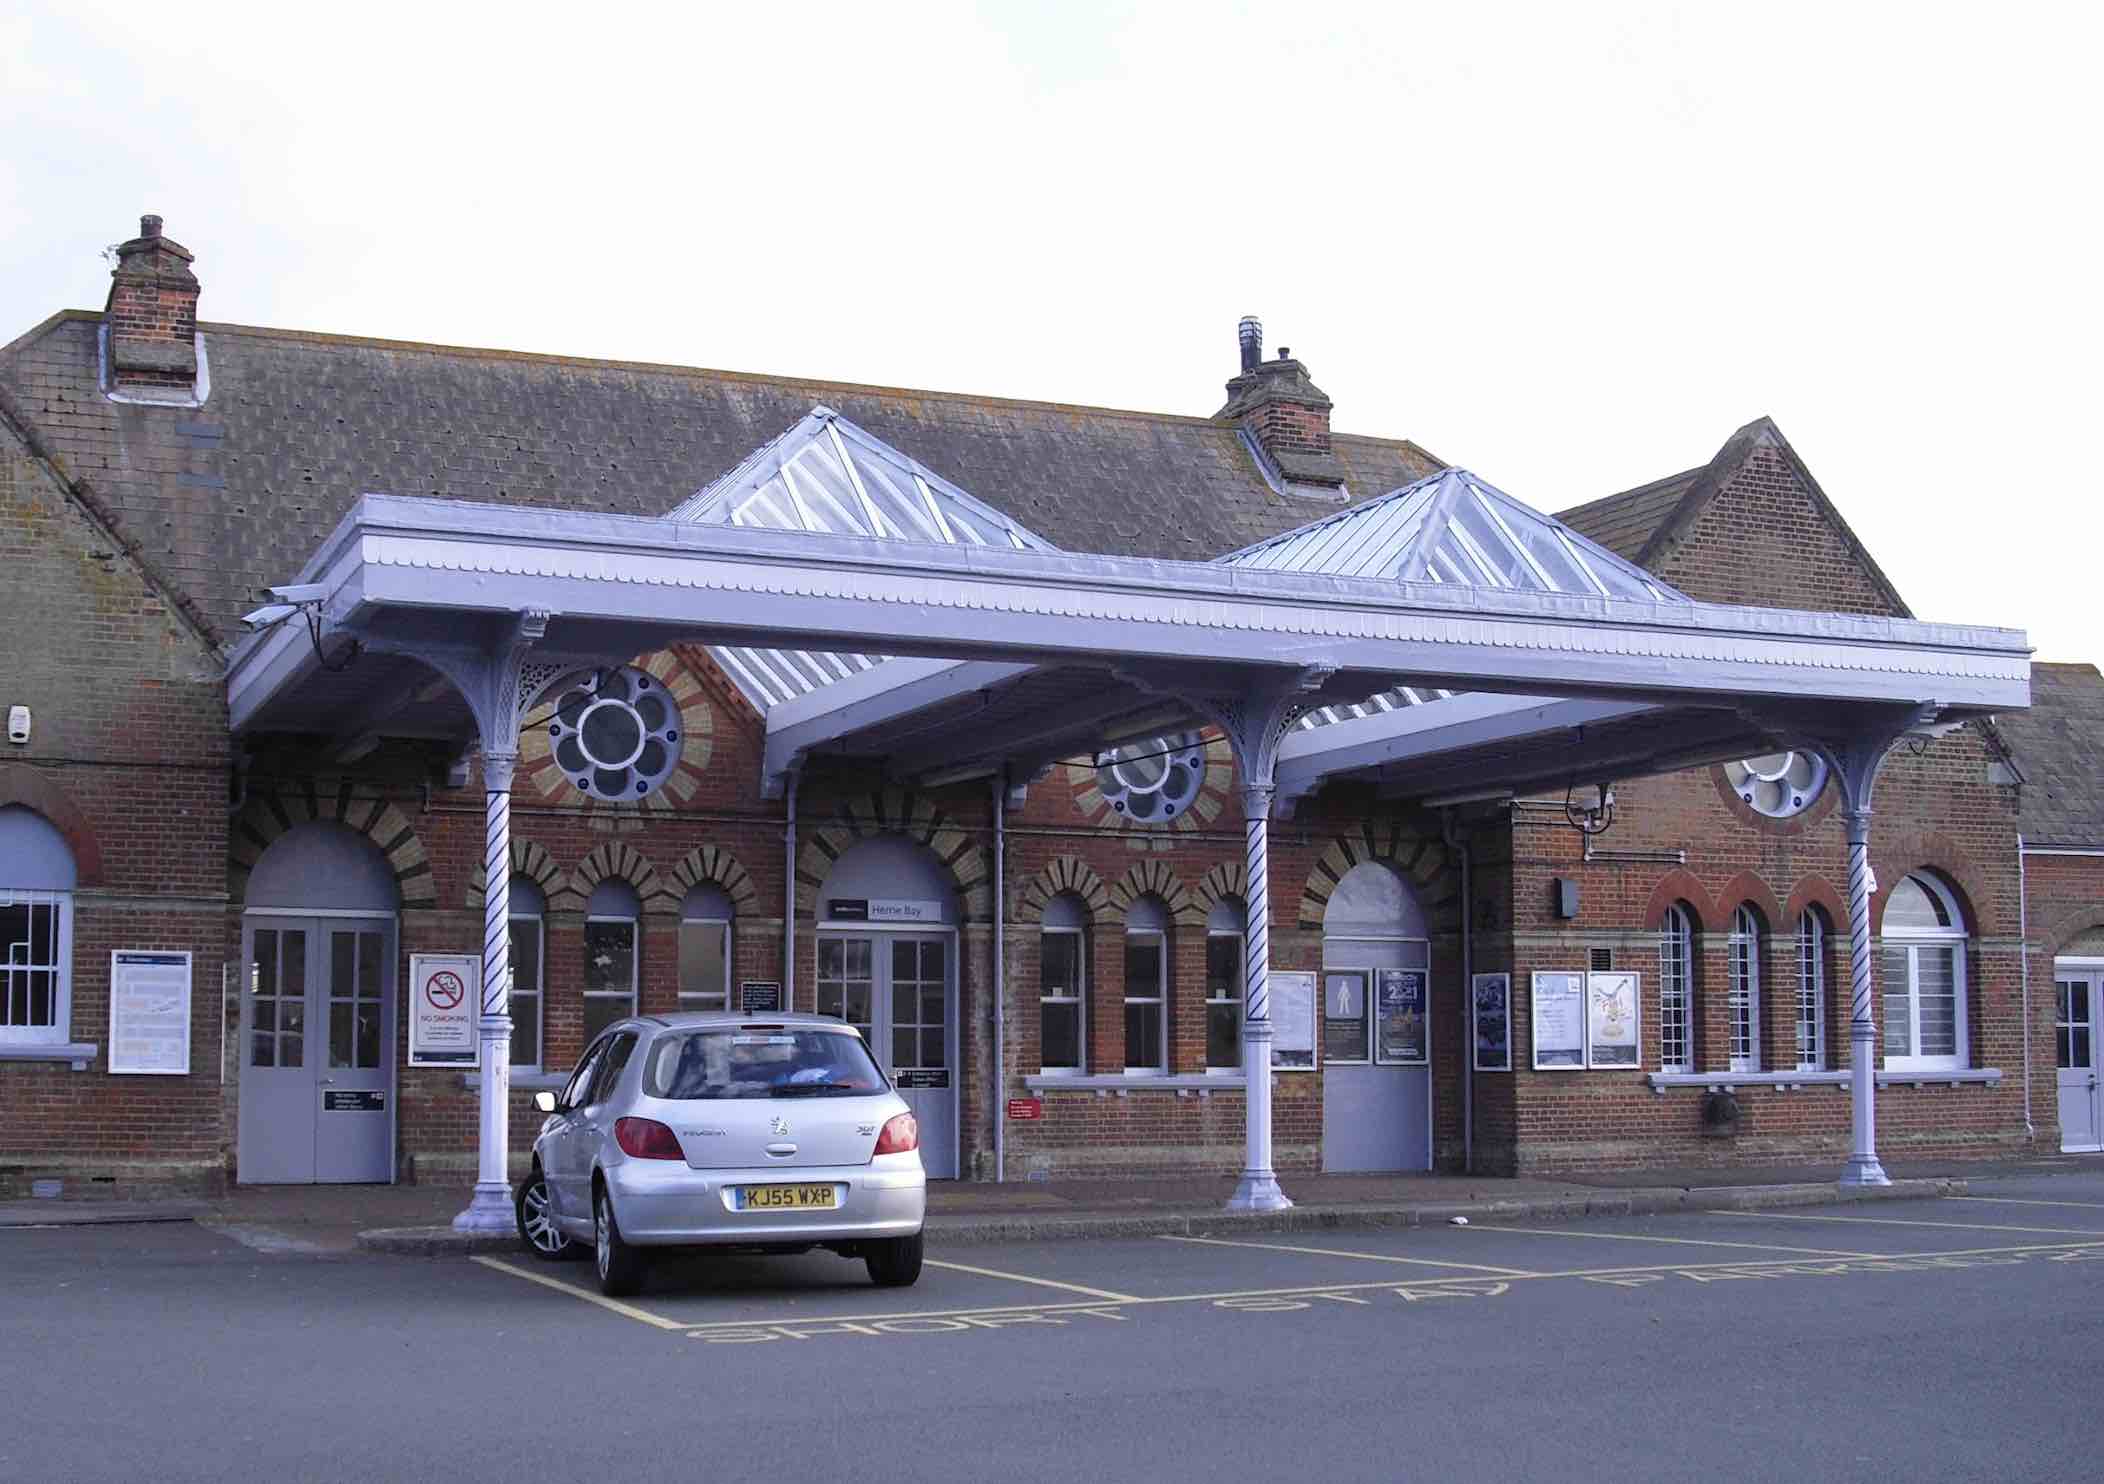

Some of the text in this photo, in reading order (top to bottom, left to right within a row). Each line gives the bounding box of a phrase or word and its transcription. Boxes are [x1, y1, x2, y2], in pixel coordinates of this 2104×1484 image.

[872, 904, 902, 914] Herne
[904, 904, 922, 918] Bay
[748, 1188, 832, 1206] KJ55 WXP
[686, 1307, 1128, 1343] SHORT
[1212, 1282, 1510, 1311] STAY
[1580, 1255, 2026, 1287] PARKING
